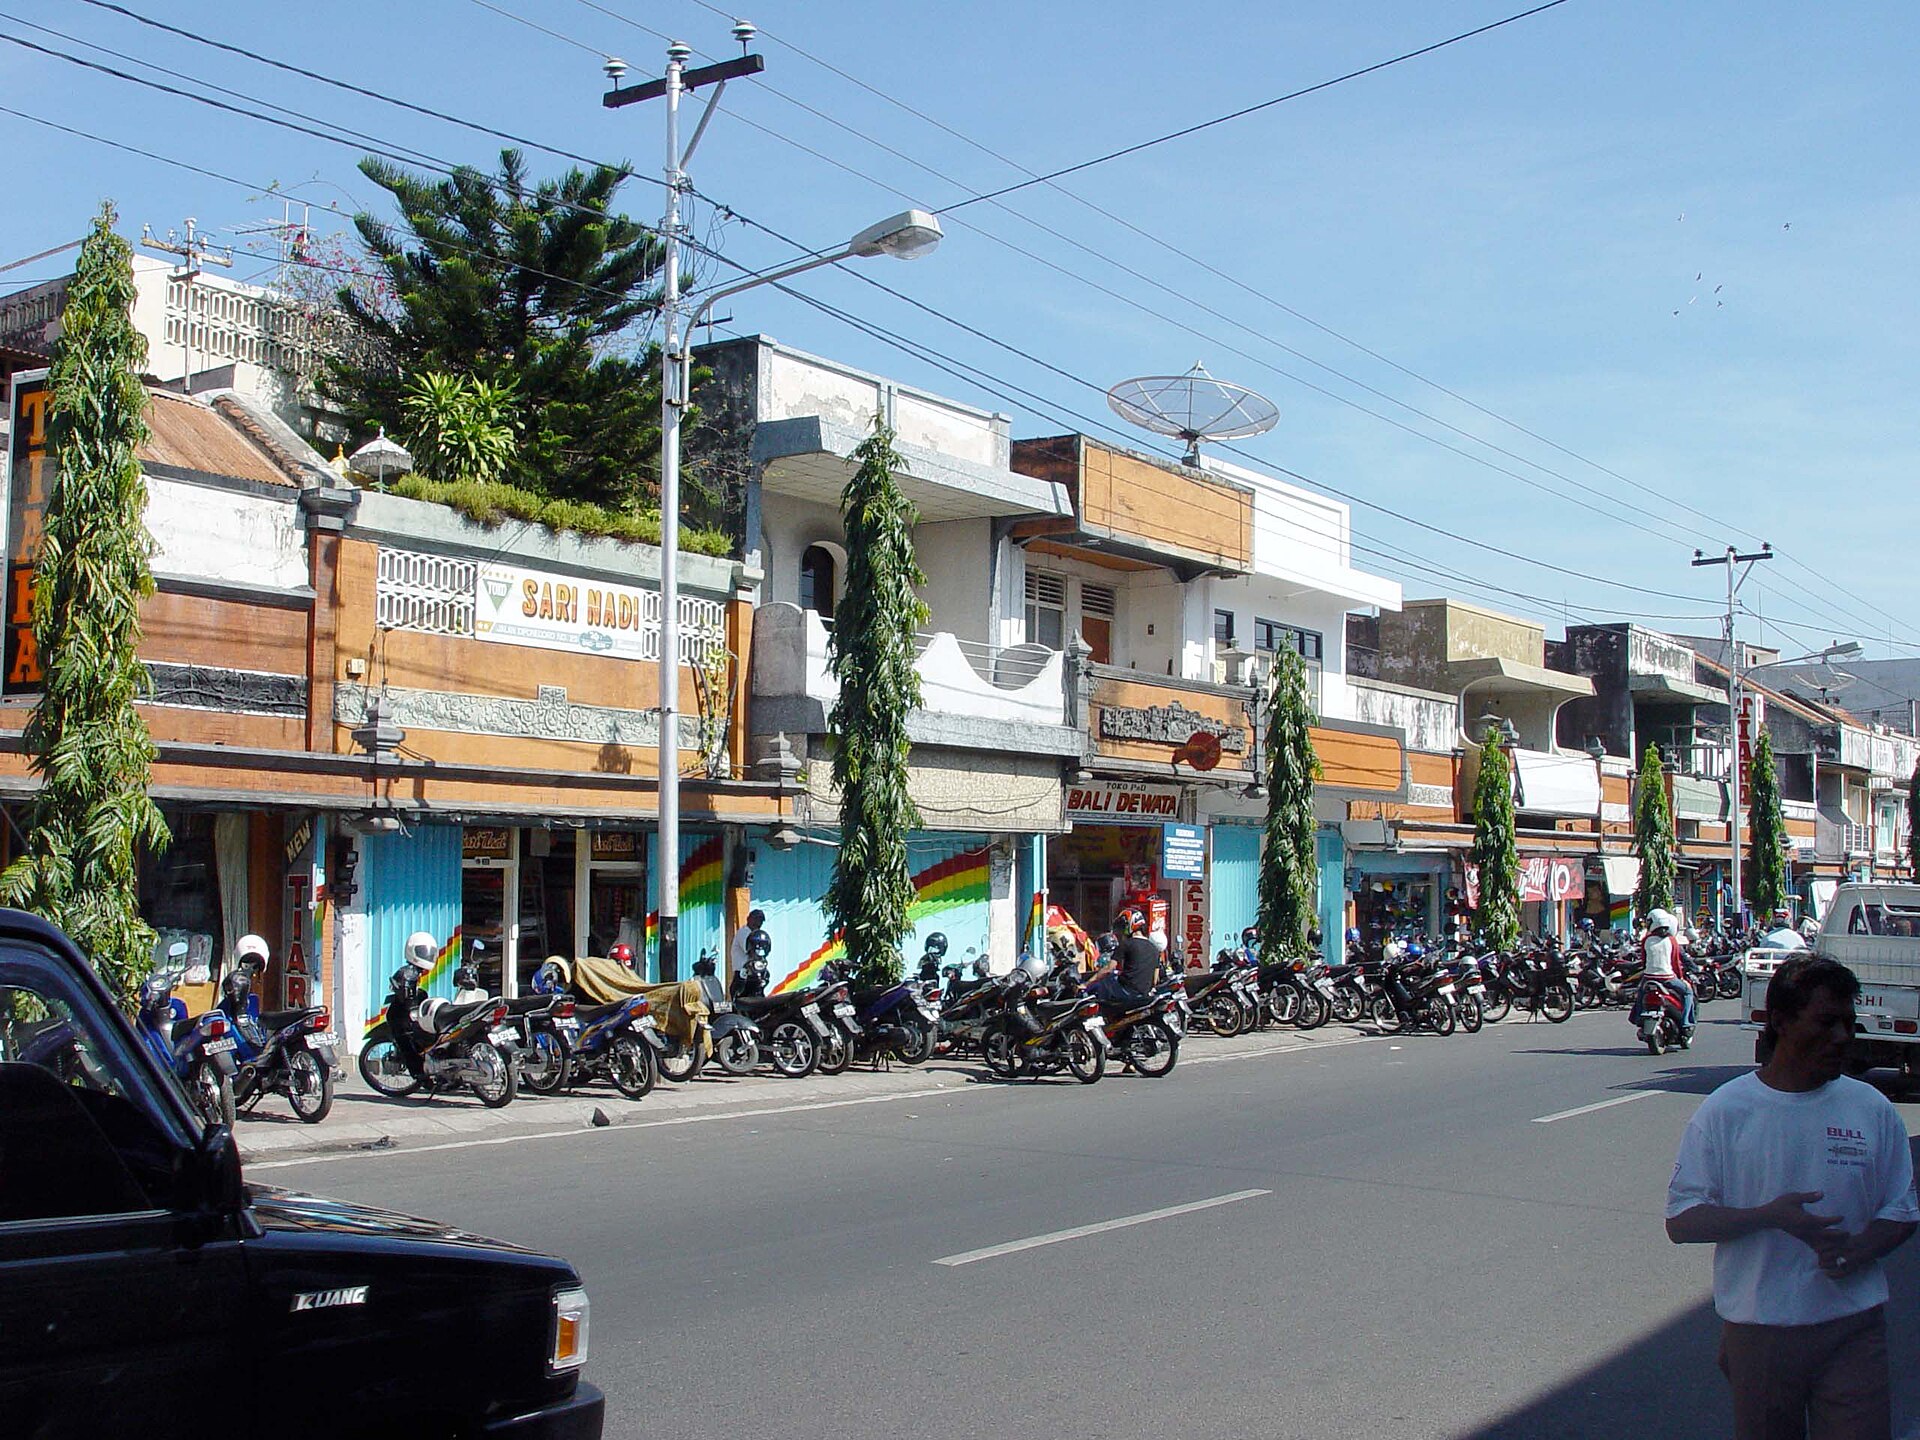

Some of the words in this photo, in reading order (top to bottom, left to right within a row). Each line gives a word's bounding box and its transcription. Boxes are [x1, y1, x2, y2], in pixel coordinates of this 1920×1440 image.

[521, 578, 578, 624] SARI
[587, 588, 639, 632] NADI
[1106, 782, 1128, 790] TOKO
[1067, 789, 1112, 811] BALI
[1116, 792, 1177, 815] DEWATA
[285, 819, 311, 864] NEW
[1187, 879, 1204, 911] ALI
[1186, 914, 1205, 970] DEWATA
[1826, 1127, 1866, 1140] BULL
[289, 1285, 371, 1313] KIJANG
